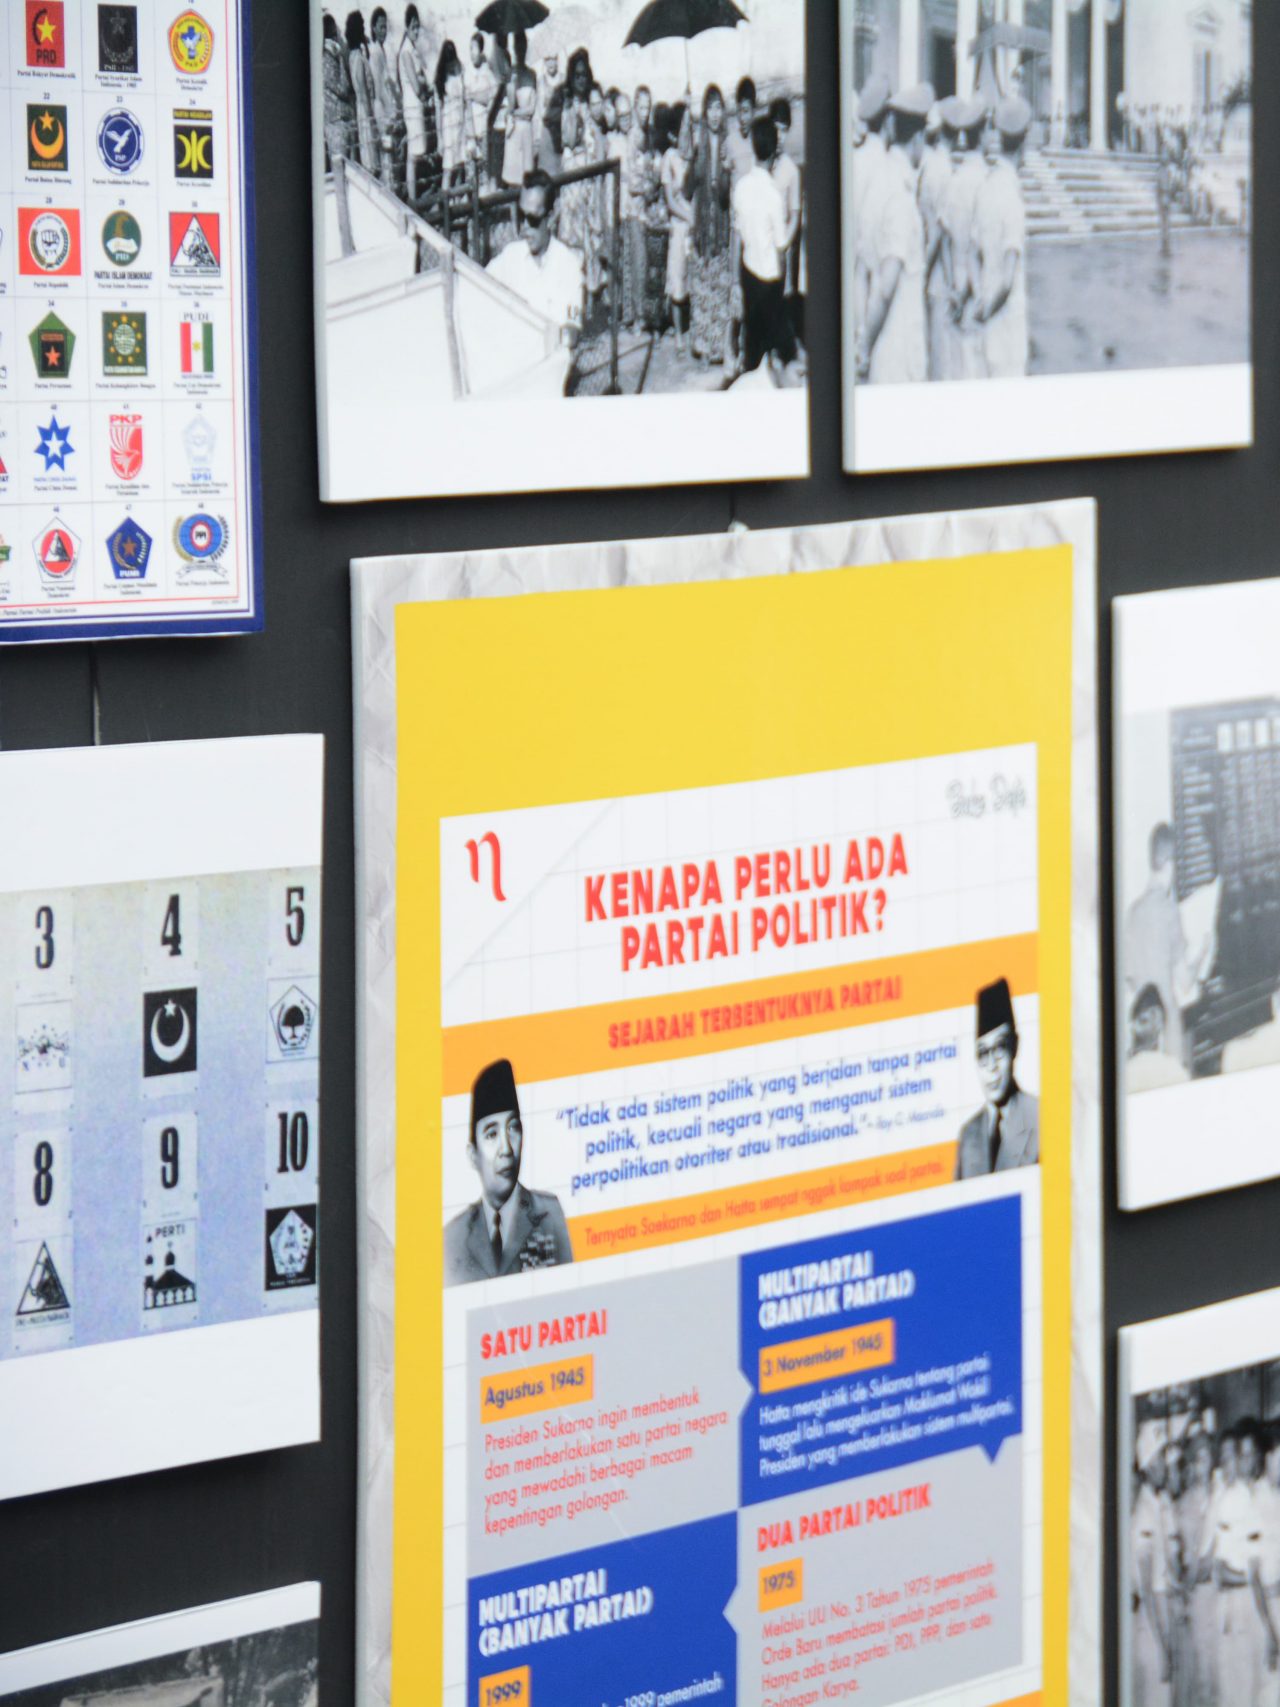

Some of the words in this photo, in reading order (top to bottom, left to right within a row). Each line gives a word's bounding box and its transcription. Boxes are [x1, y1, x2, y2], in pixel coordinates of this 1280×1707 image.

[37, 49, 56, 64] PRD
[109, 414, 142, 425] PKP
[585, 859, 723, 922] KENAPA
[735, 843, 831, 900] PERLU
[843, 833, 908, 883] ADA
[35, 906, 54, 969] 3
[161, 894, 181, 956] 4
[286, 887, 304, 946] 5
[621, 911, 739, 972] PARTAI
[752, 888, 887, 952] POLITIK?
[609, 1011, 696, 1049] SEJARAH
[700, 987, 835, 1034] TERBENTUKNYA
[841, 975, 902, 1009] PARTAI
[617, 1096, 647, 1120] ada
[654, 1093, 701, 1114] sistem
[707, 1075, 753, 1111] politik
[760, 1075, 796, 1100] yang
[802, 1056, 862, 1087] berjalan
[868, 1054, 909, 1074] tanpa
[915, 1036, 957, 1069] partai
[277, 1111, 308, 1173] 10
[586, 1127, 640, 1162] politik,
[648, 1116, 701, 1146] kecuali
[708, 1111, 761, 1136] negara
[768, 1102, 804, 1127] yang
[810, 1086, 882, 1113] menganut
[889, 1077, 932, 1098] sistem
[34, 1140, 53, 1206] 8
[160, 1127, 179, 1189] 9
[572, 1156, 669, 1195] perpolitikan
[675, 1144, 732, 1170] otoriter
[738, 1139, 771, 1158] atau
[155, 1223, 185, 1238] PERTI
[586, 1223, 636, 1247] Ternyata
[641, 1212, 696, 1234] Soekarno
[701, 1203, 721, 1223] dan
[725, 1199, 756, 1217] Hatta
[760, 1190, 799, 1212] sempat
[840, 1175, 881, 1195] kompak
[758, 1250, 874, 1300] MULTIPARTAI
[481, 1324, 532, 1359] SATU
[538, 1309, 607, 1348] PARTAI
[759, 1287, 841, 1330] (BANYAK
[777, 1346, 845, 1373] November
[852, 1333, 882, 1355] 1945
[485, 1380, 544, 1409] Agustus
[551, 1367, 585, 1391] 1945
[760, 1404, 790, 1426] Hatta
[870, 1375, 912, 1399] Sukarno
[915, 1365, 954, 1388] tentang
[956, 1351, 991, 1377] partai
[484, 1426, 538, 1452] Presiden
[543, 1414, 594, 1440] Sukarno
[598, 1405, 627, 1430] ingin
[632, 1387, 699, 1412] membentuk
[484, 1460, 509, 1481] dan
[514, 1433, 613, 1473] memberlakukan
[617, 1430, 640, 1450] satu
[645, 1421, 680, 1445] partai
[685, 1409, 728, 1435] negara
[759, 1424, 800, 1452] tunggal
[803, 1421, 824, 1440] lalu
[826, 1403, 902, 1435] mengeluarkan
[760, 1450, 804, 1478] Presiden
[807, 1448, 838, 1471] yang
[838, 1419, 922, 1457] memberlakukan
[924, 1412, 955, 1435] sistem
[484, 1488, 517, 1513] yang
[522, 1471, 585, 1498] mewadahi
[590, 1457, 646, 1482] berbagai
[650, 1446, 693, 1467] macam
[484, 1500, 562, 1536] kepentingan
[567, 1489, 629, 1519] golongan.
[758, 1520, 794, 1552] DUA
[799, 1502, 861, 1540] PARTAI
[867, 1483, 932, 1523] POLITIK
[479, 1568, 607, 1626] MULTIPARTAI
[762, 1612, 804, 1640] Melalui
[809, 1608, 825, 1627] UU
[867, 1590, 900, 1609] Tahun
[904, 1576, 930, 1595] 1975
[935, 1557, 994, 1591] pemerintah
[763, 1570, 796, 1594] 1975
[479, 1608, 570, 1657] (BANYAK
[574, 1586, 653, 1631] PARTAI)
[762, 1645, 792, 1665] Orde
[796, 1632, 822, 1655] Baru
[826, 1620, 885, 1648] membatasi
[890, 1607, 925, 1632] jumlah
[928, 1597, 960, 1619] partai
[762, 1671, 798, 1691] Hanya
[803, 1660, 825, 1680] ada
[829, 1650, 850, 1672] dua
[946, 1620, 966, 1638] dan
[970, 1613, 992, 1630] satu
[486, 1680, 521, 1706] 1999
